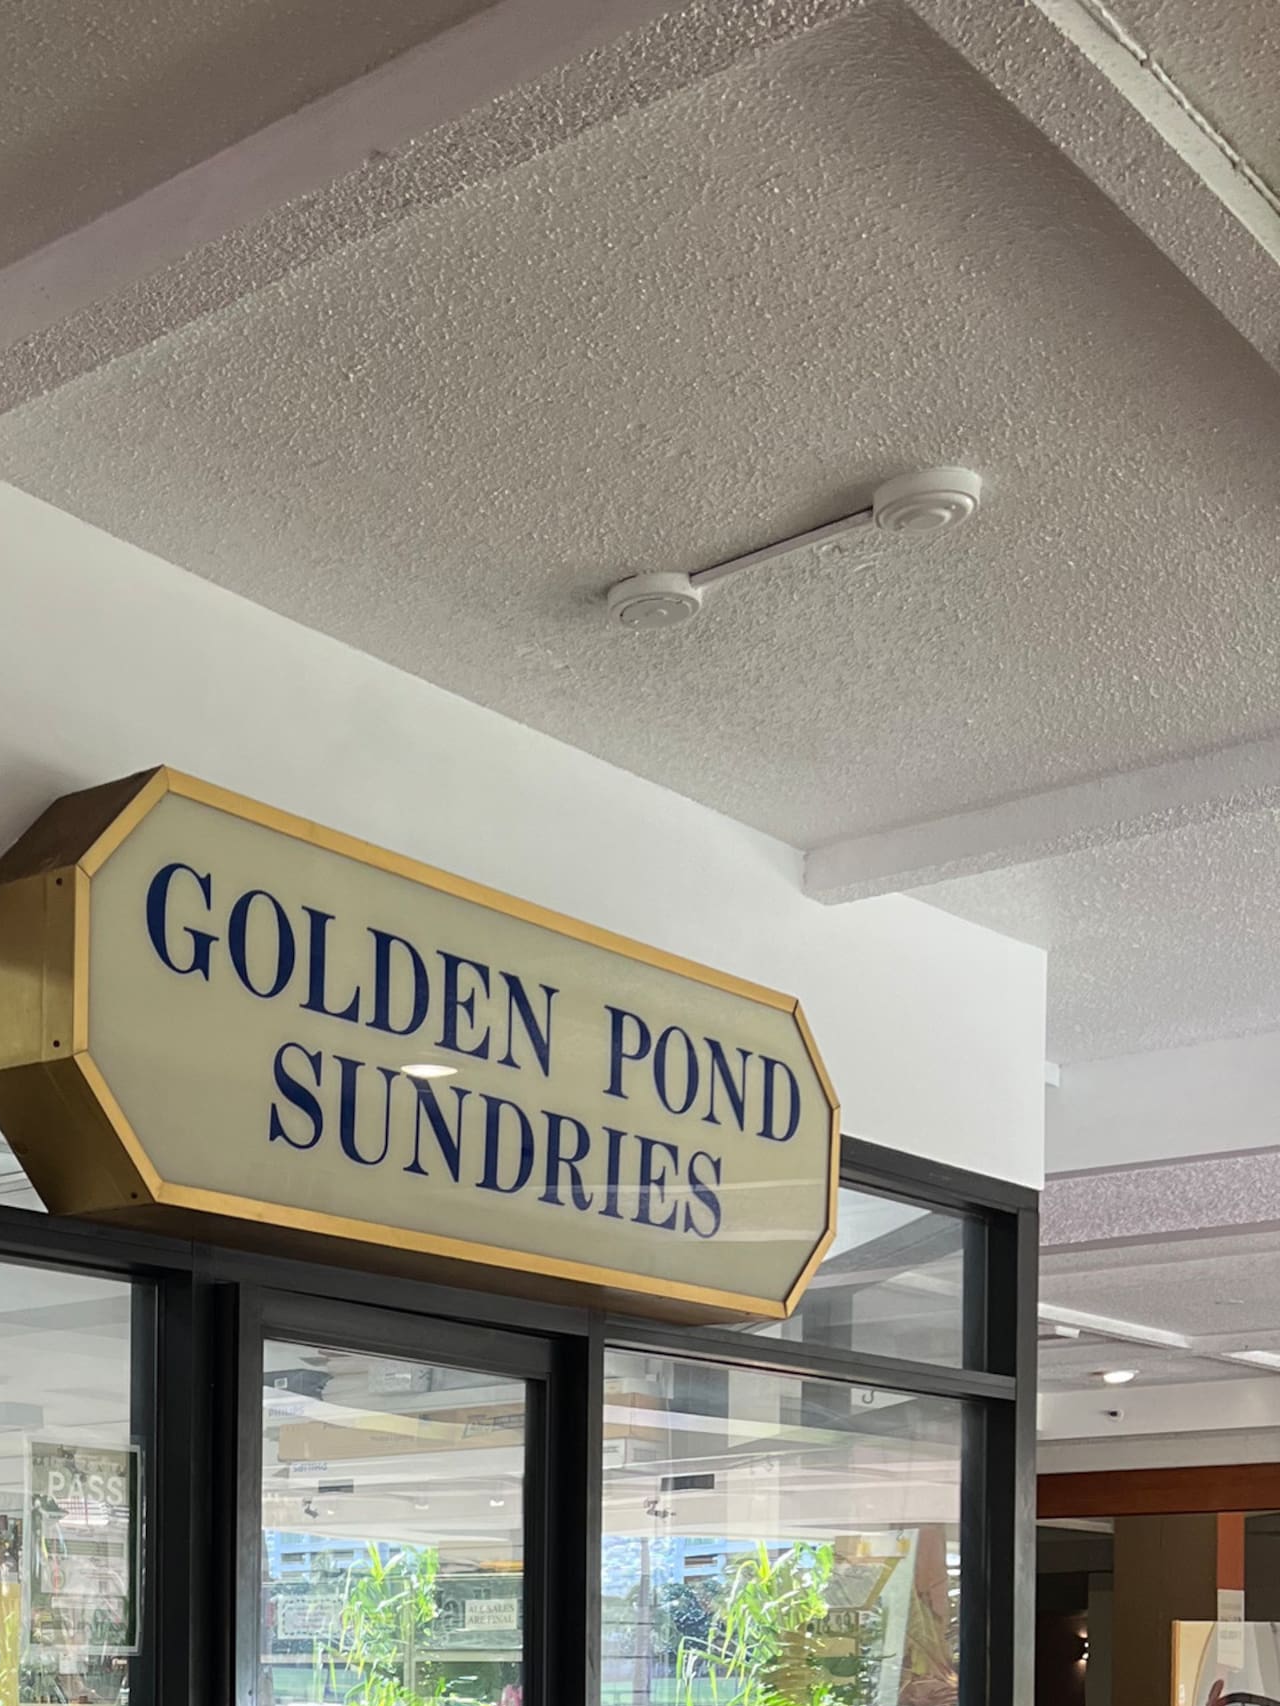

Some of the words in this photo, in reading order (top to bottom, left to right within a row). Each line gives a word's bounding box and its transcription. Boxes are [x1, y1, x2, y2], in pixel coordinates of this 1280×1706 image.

[146, 861, 560, 1078] GOLDEN
[605, 1004, 801, 1143] POND
[269, 1041, 723, 1238] SUNDRIES
[48, 1470, 125, 1505] PASS
[487, 1614, 514, 1625] FINAL
